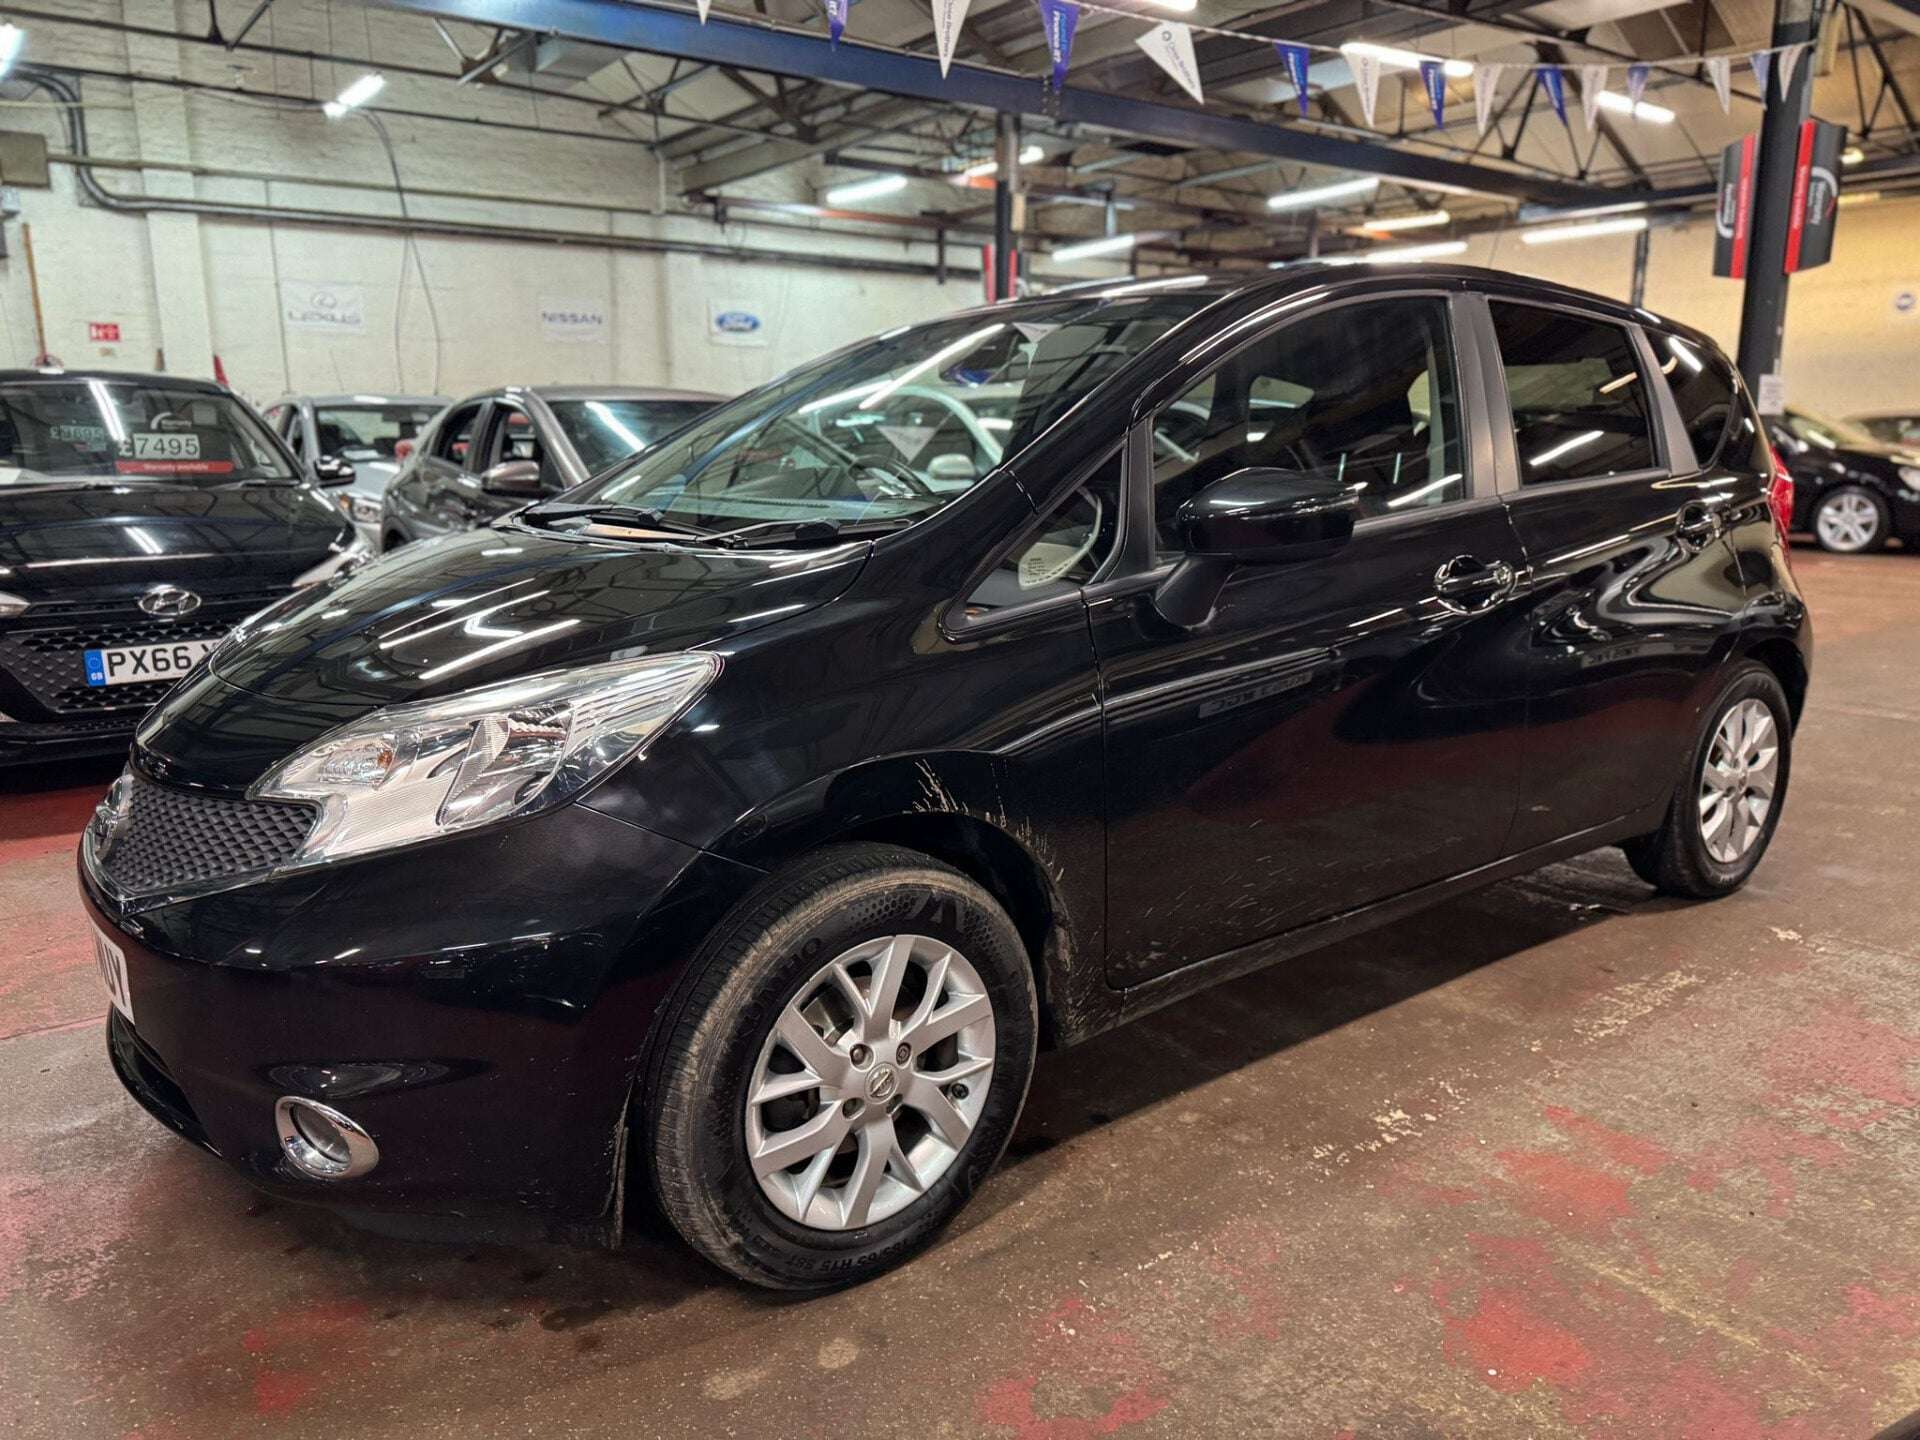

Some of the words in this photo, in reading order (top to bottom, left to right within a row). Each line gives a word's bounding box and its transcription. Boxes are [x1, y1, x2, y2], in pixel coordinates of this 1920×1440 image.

[1810, 181, 1828, 225] Warranty
[541, 312, 603, 325] NISSAN
[107, 645, 192, 677] PX66
